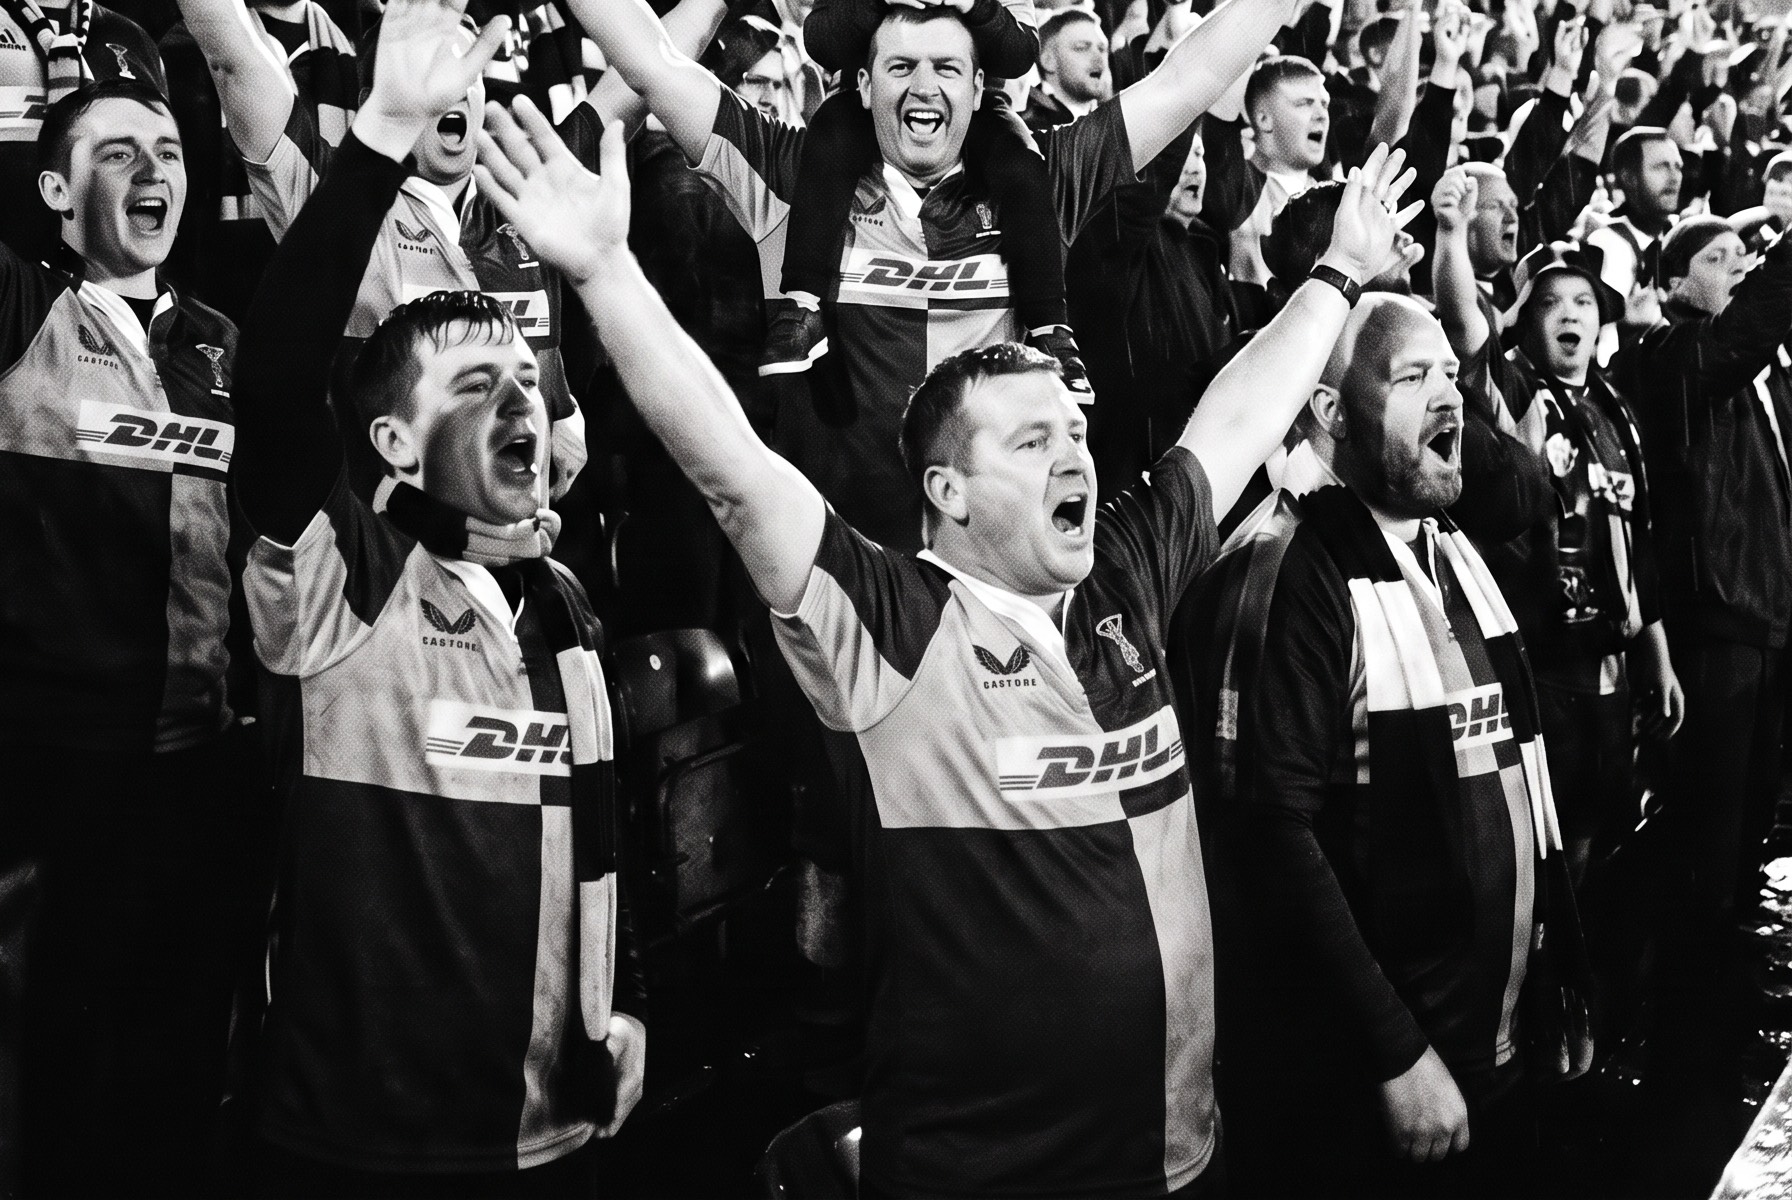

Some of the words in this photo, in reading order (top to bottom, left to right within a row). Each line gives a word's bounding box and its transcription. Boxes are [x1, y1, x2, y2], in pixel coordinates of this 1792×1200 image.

[862, 257, 990, 292] DHL
[103, 413, 224, 461] DHL
[983, 678, 1037, 689] CASTORE
[1035, 723, 1170, 790] DHL
